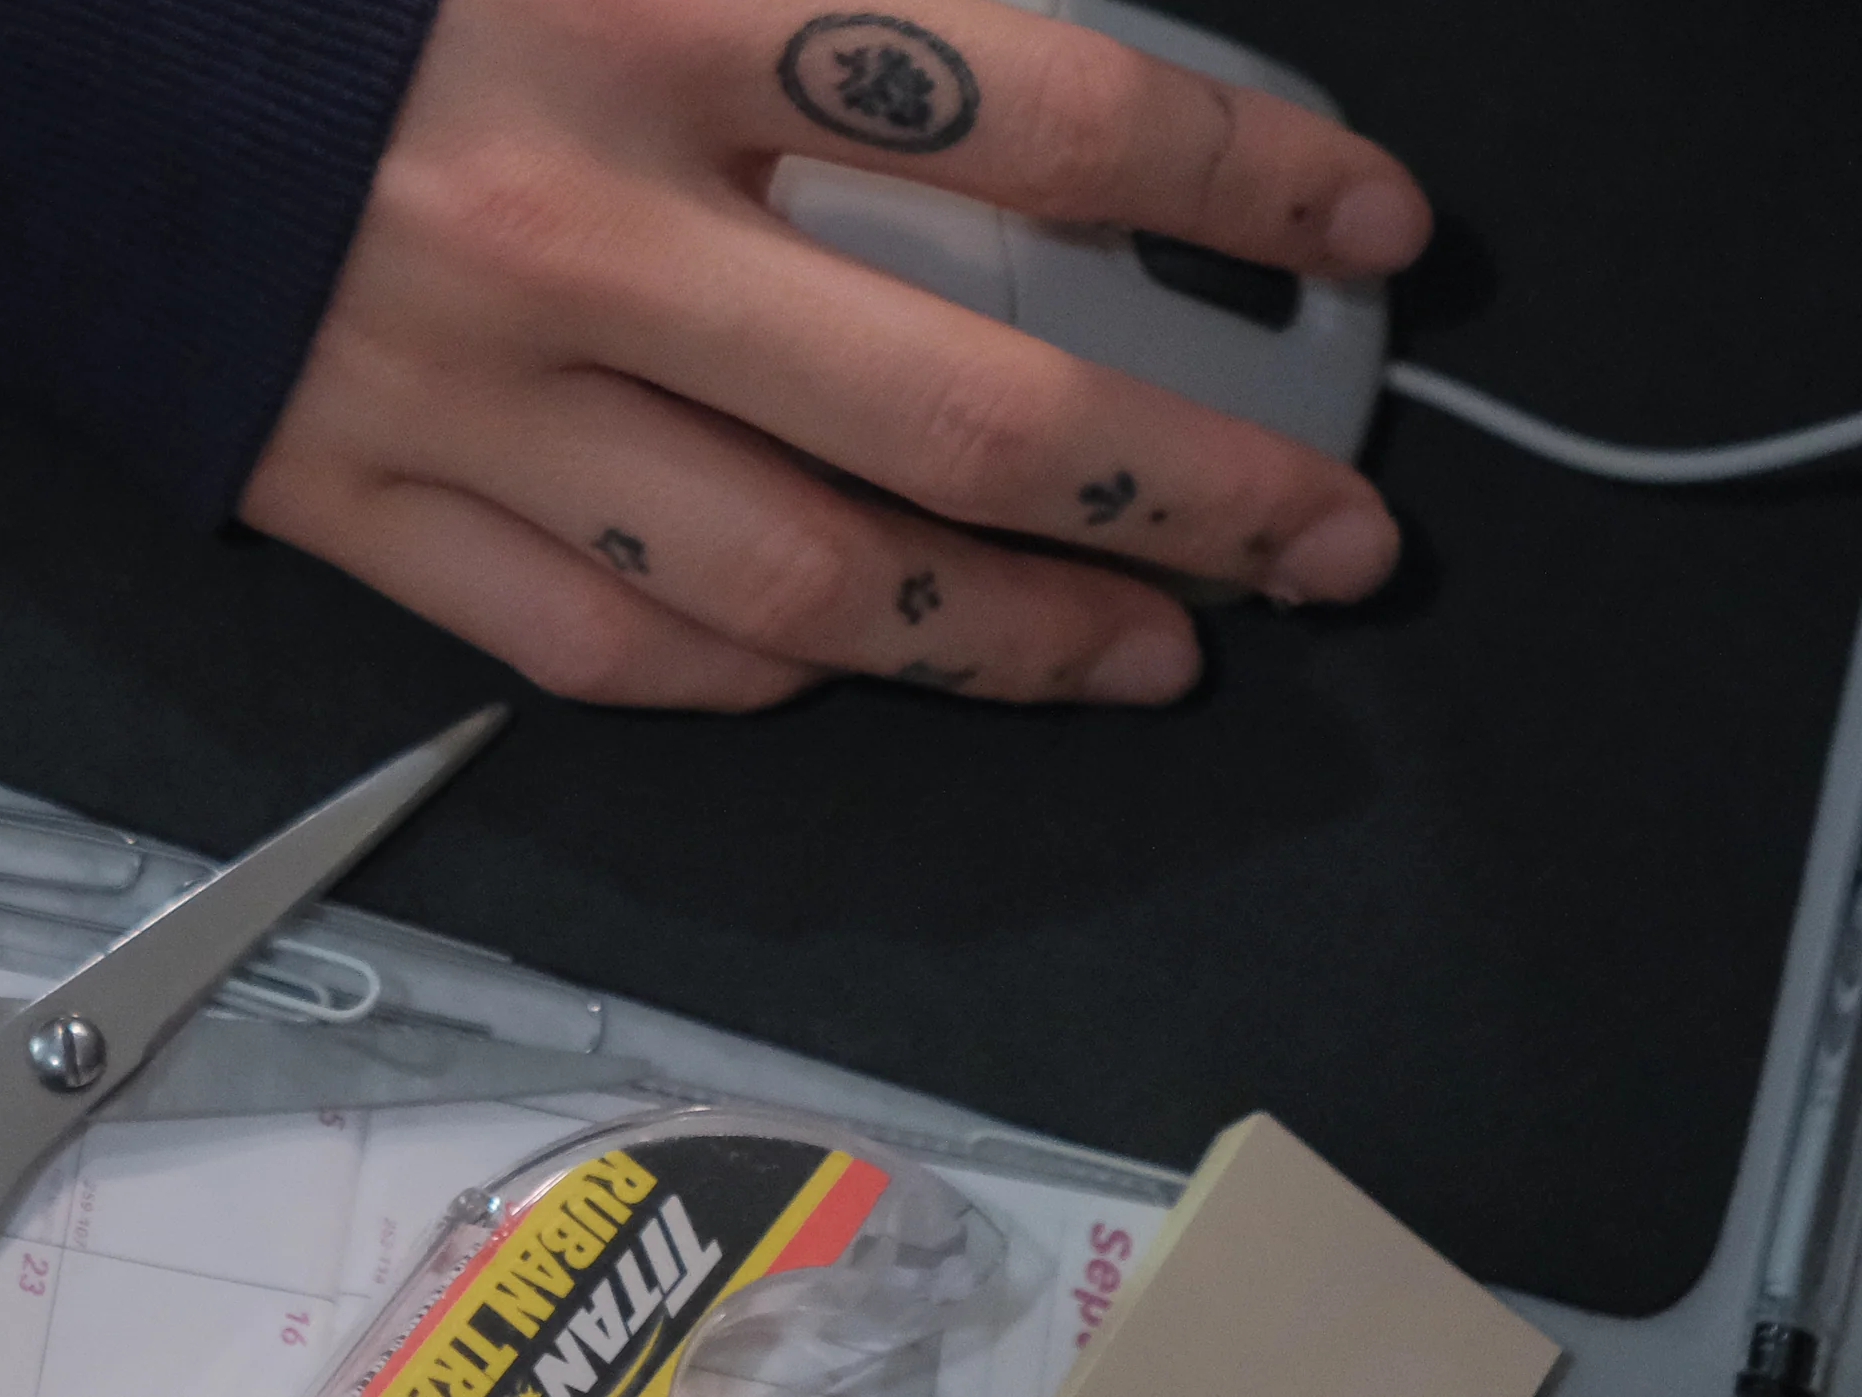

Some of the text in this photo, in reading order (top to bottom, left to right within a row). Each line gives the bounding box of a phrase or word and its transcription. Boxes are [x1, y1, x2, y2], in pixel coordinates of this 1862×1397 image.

[18, 1252, 50, 1297] 23
[483, 1149, 659, 1341] RUBAN
[533, 1194, 723, 1397] TITAN
[1072, 1221, 1132, 1349] Sep
[280, 1311, 311, 1347] 16
